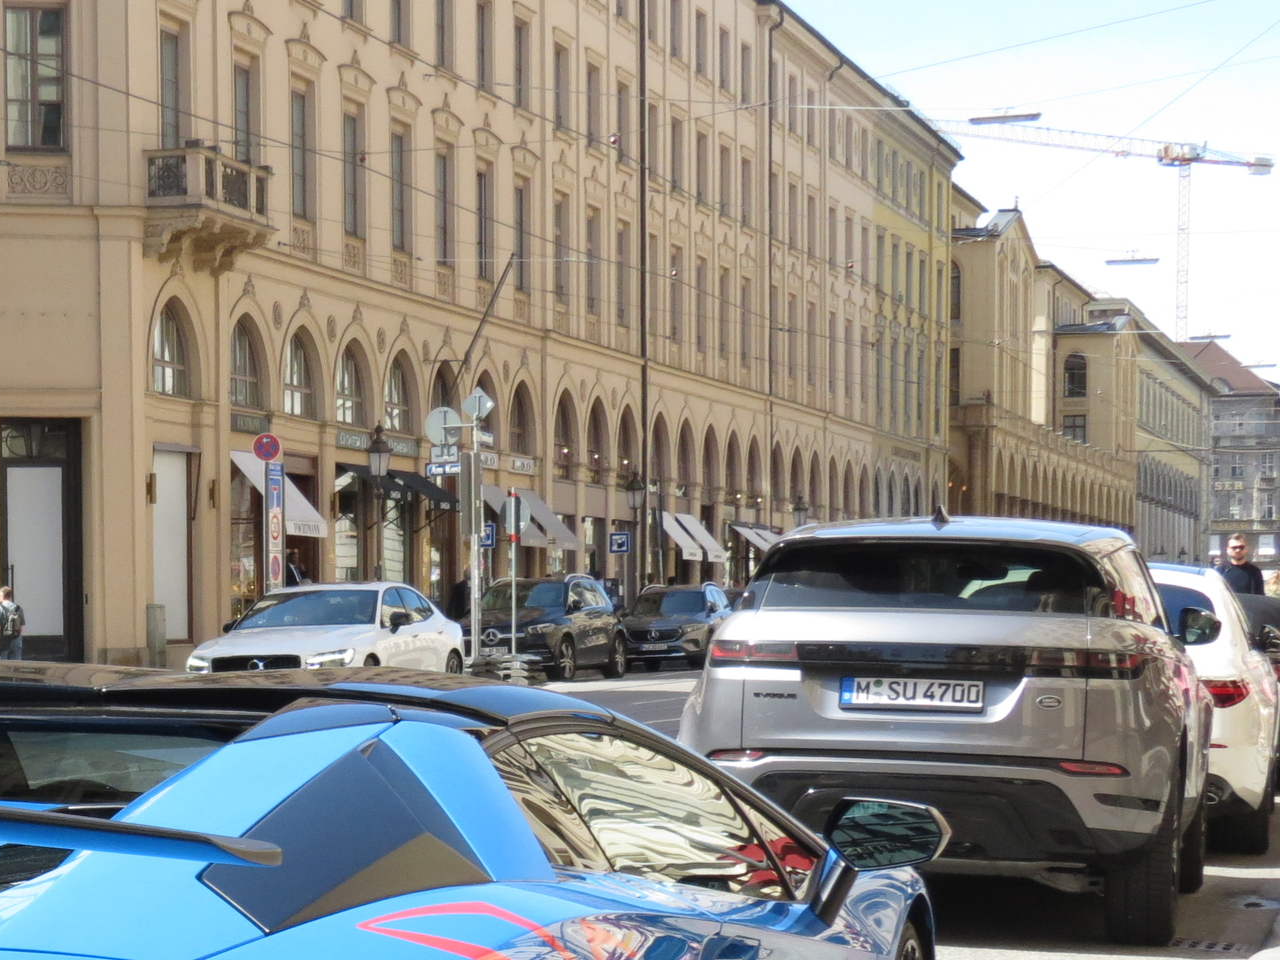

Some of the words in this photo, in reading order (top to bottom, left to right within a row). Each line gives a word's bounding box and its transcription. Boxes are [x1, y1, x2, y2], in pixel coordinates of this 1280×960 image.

[430, 465, 443, 475] Am
[1212, 481, 1244, 491] SER
[753, 692, 797, 700] EVOQUE
[856, 684, 870, 701] M
[887, 683, 918, 702] SU
[922, 682, 981, 704] 4700
